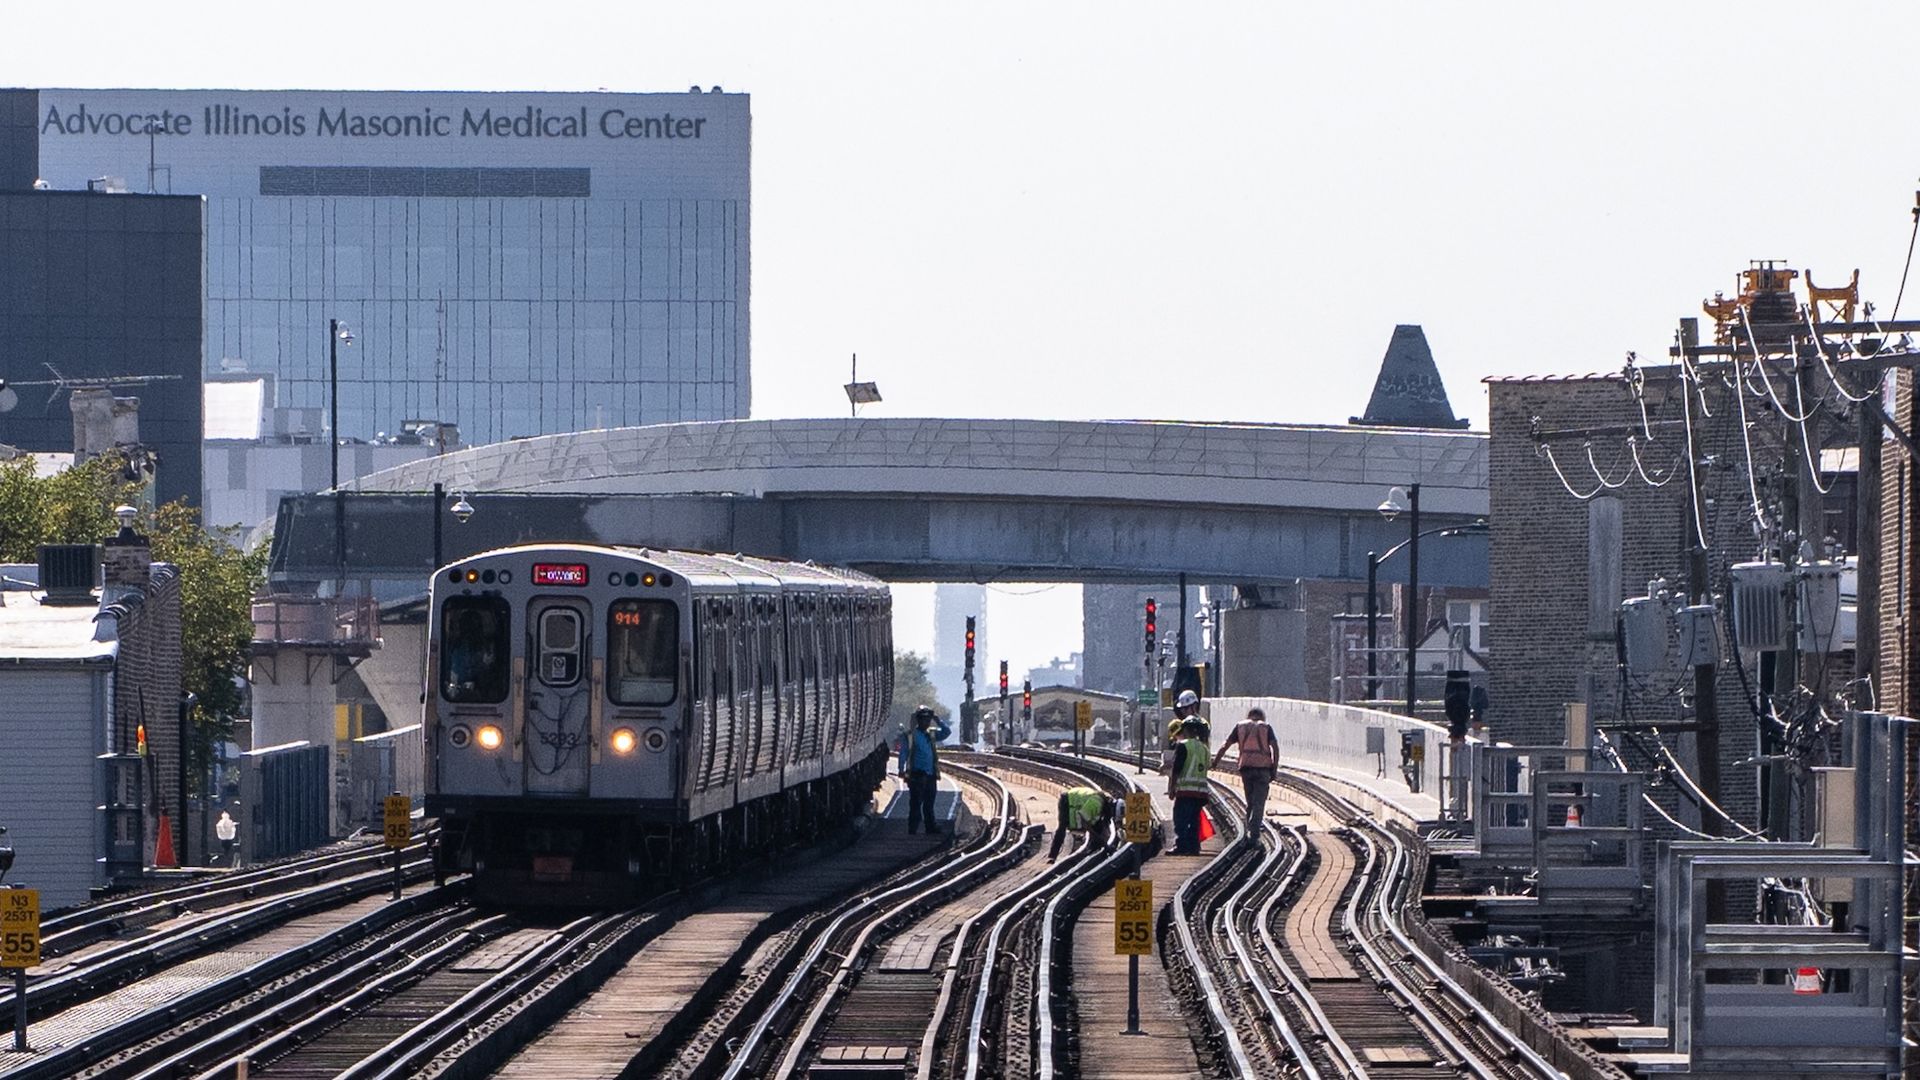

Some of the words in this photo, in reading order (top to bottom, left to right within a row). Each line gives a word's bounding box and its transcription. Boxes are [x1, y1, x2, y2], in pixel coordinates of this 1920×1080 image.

[41, 103, 192, 135] Advocate
[203, 104, 306, 136] Illinois
[316, 106, 450, 137] Masonic
[459, 106, 587, 138] Medical
[599, 109, 707, 139] Center
[616, 612, 640, 624] 914
[388, 823, 407, 838] 35
[1128, 820, 1149, 834] 45
[1126, 886, 1143, 897] N2
[11, 895, 28, 907] N3
[4, 911, 34, 921] 253T
[1120, 921, 1149, 942] 55
[5, 932, 35, 953] 55
